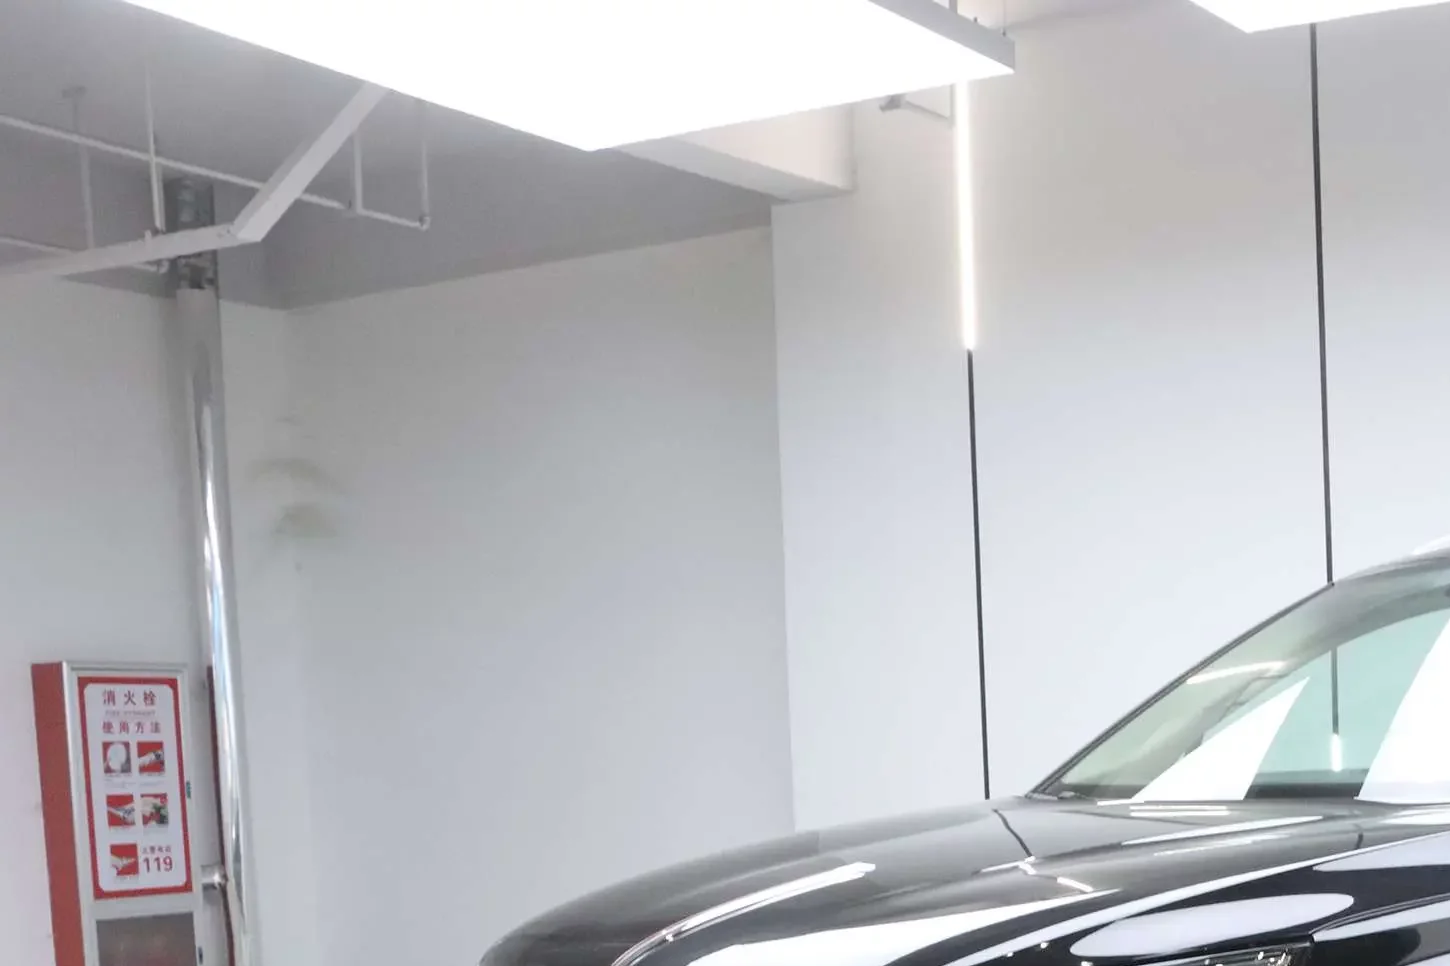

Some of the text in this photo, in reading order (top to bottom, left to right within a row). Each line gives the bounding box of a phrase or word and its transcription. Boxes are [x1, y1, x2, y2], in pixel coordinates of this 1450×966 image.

[102, 688, 157, 706] 消火栓
[143, 856, 173, 873] 119
